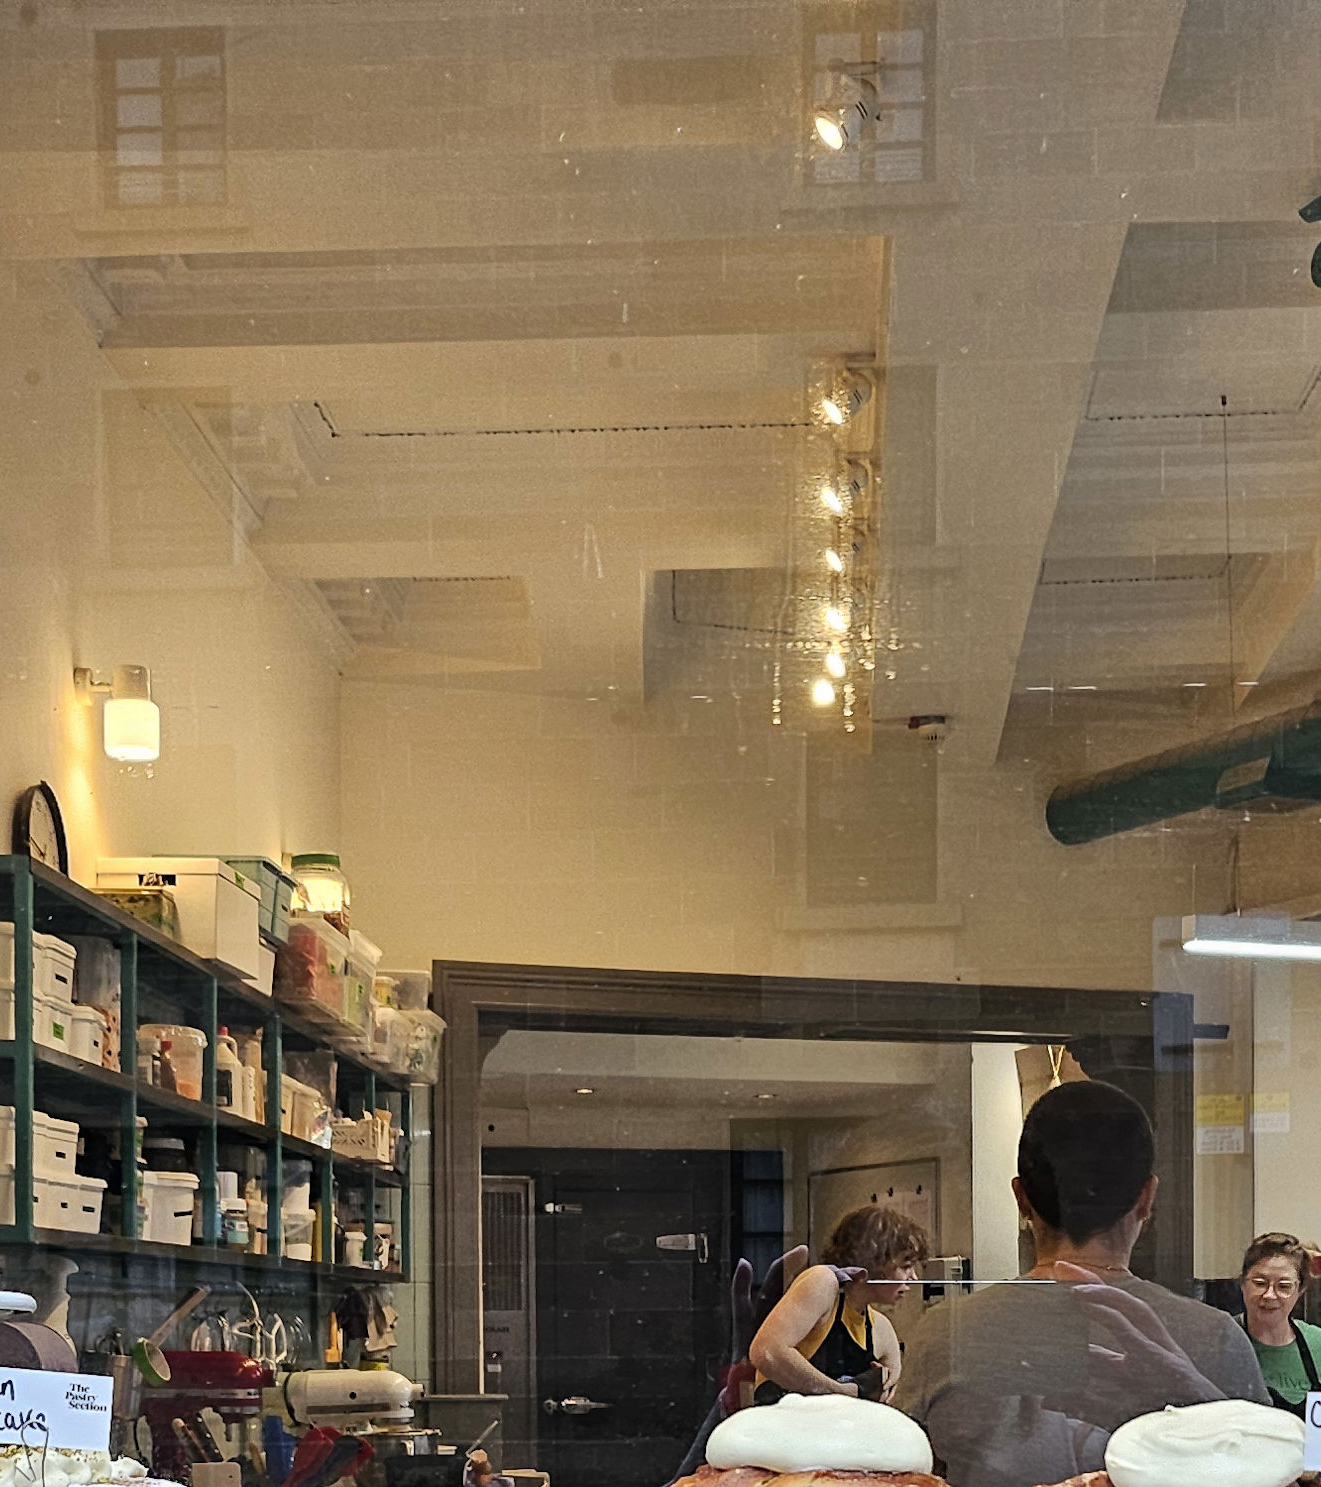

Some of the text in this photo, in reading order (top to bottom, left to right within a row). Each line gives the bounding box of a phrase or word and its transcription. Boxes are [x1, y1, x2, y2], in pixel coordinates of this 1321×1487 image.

[70, 1383, 90, 1393] The
[65, 1391, 98, 1402] Pastry
[68, 1401, 107, 1412] Section
